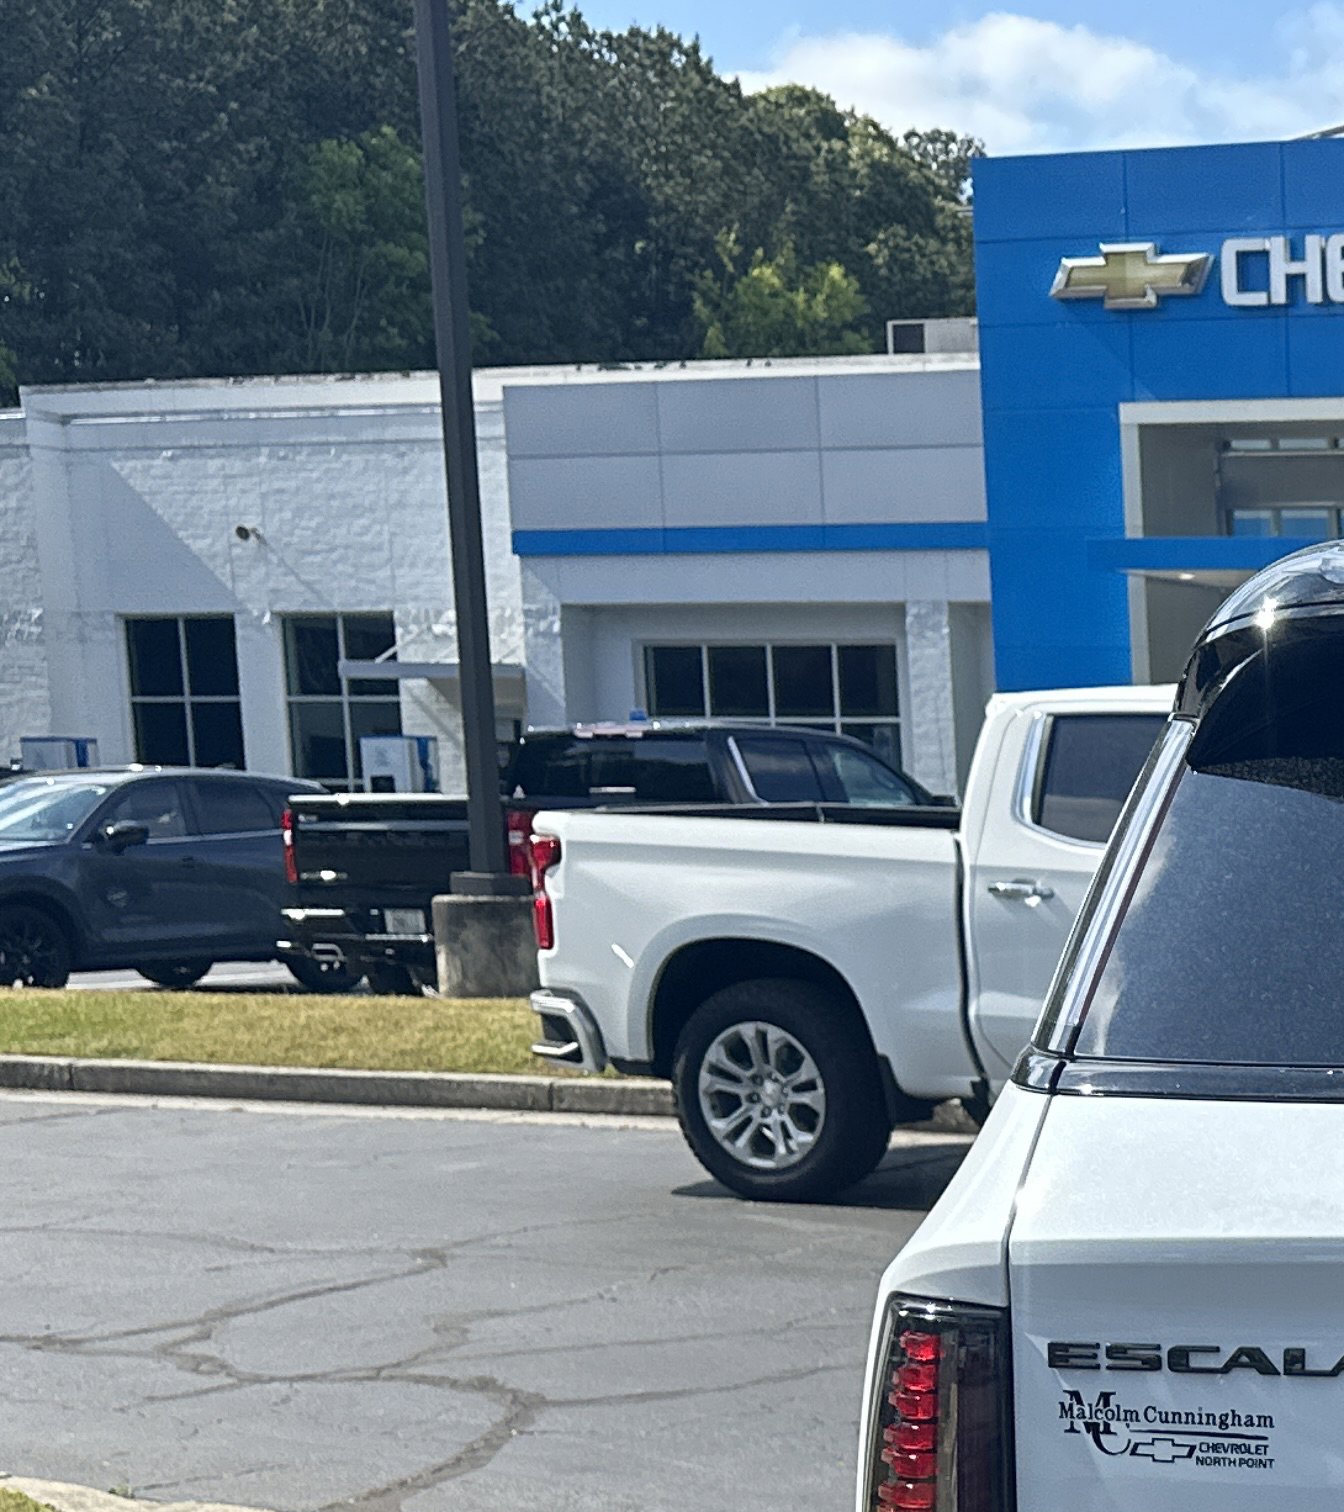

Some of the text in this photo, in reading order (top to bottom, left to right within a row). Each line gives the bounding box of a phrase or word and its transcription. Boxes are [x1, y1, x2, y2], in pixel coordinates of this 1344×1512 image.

[1058, 1401, 1275, 1430] Malcolm Cunningham
[1198, 1441, 1269, 1456] CHEVROLET
[1195, 1456, 1275, 1469] NORTH POINT
